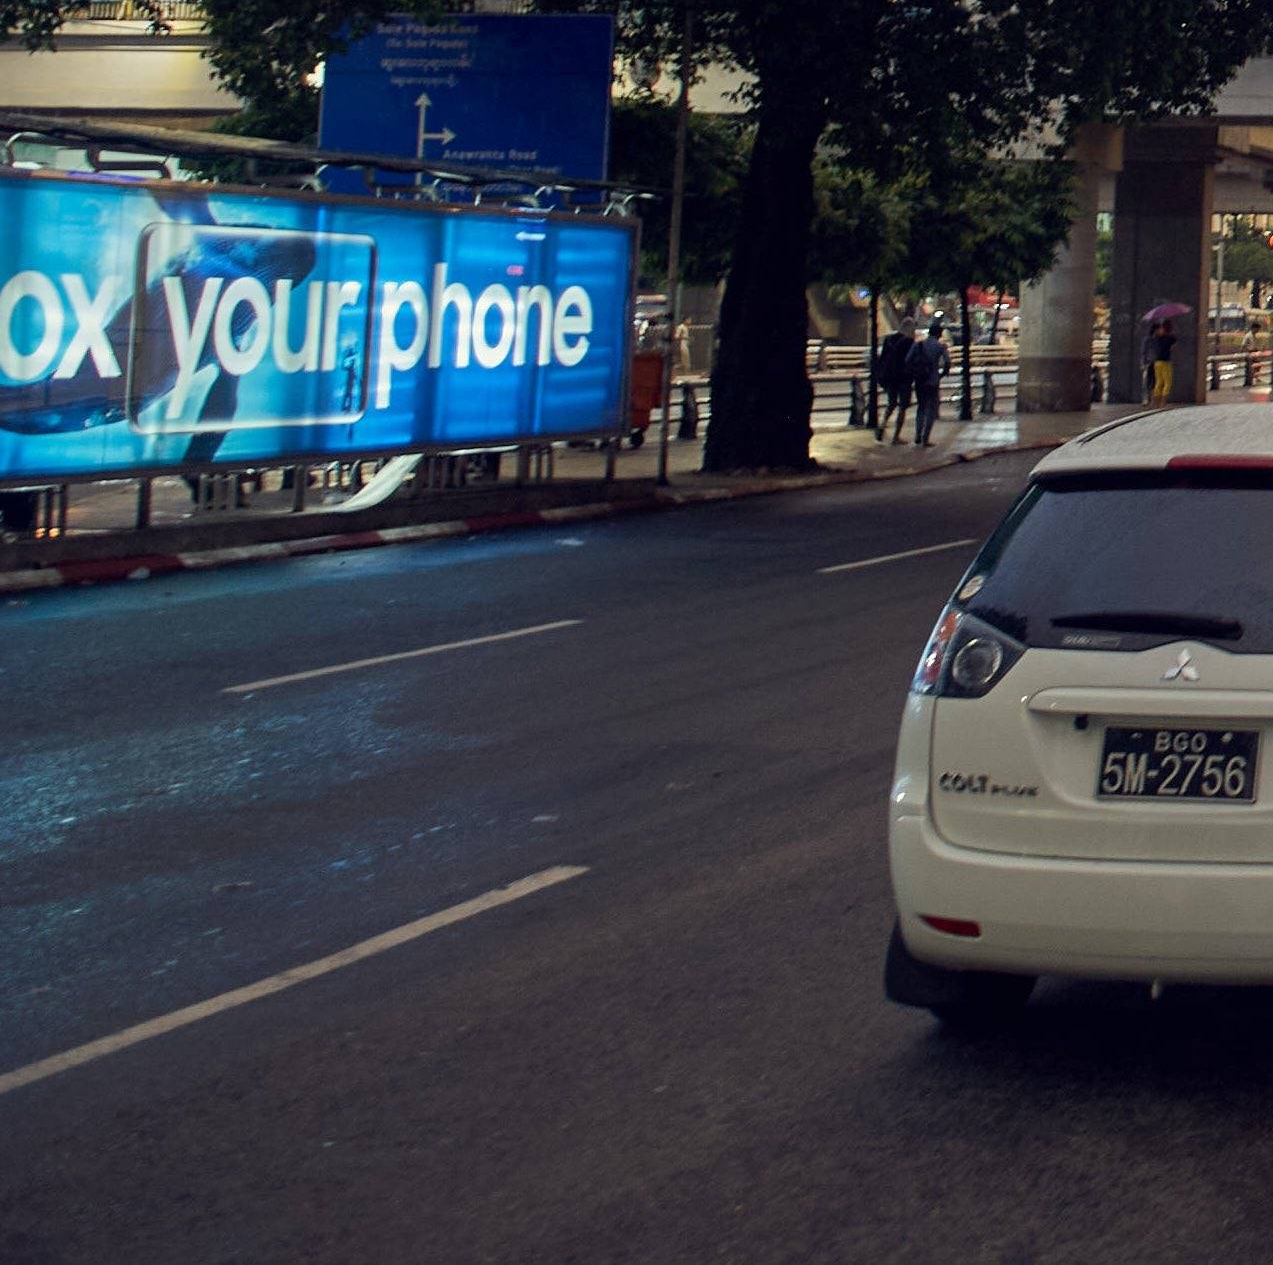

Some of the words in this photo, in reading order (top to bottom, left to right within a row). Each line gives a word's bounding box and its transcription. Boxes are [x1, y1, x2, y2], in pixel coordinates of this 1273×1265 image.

[509, 149, 538, 160] Road
[163, 276, 362, 419] your
[375, 263, 593, 410] phone
[1154, 731, 1207, 753] BGO
[939, 772, 989, 794] COLT
[1102, 751, 1247, 798] 5M-2756
